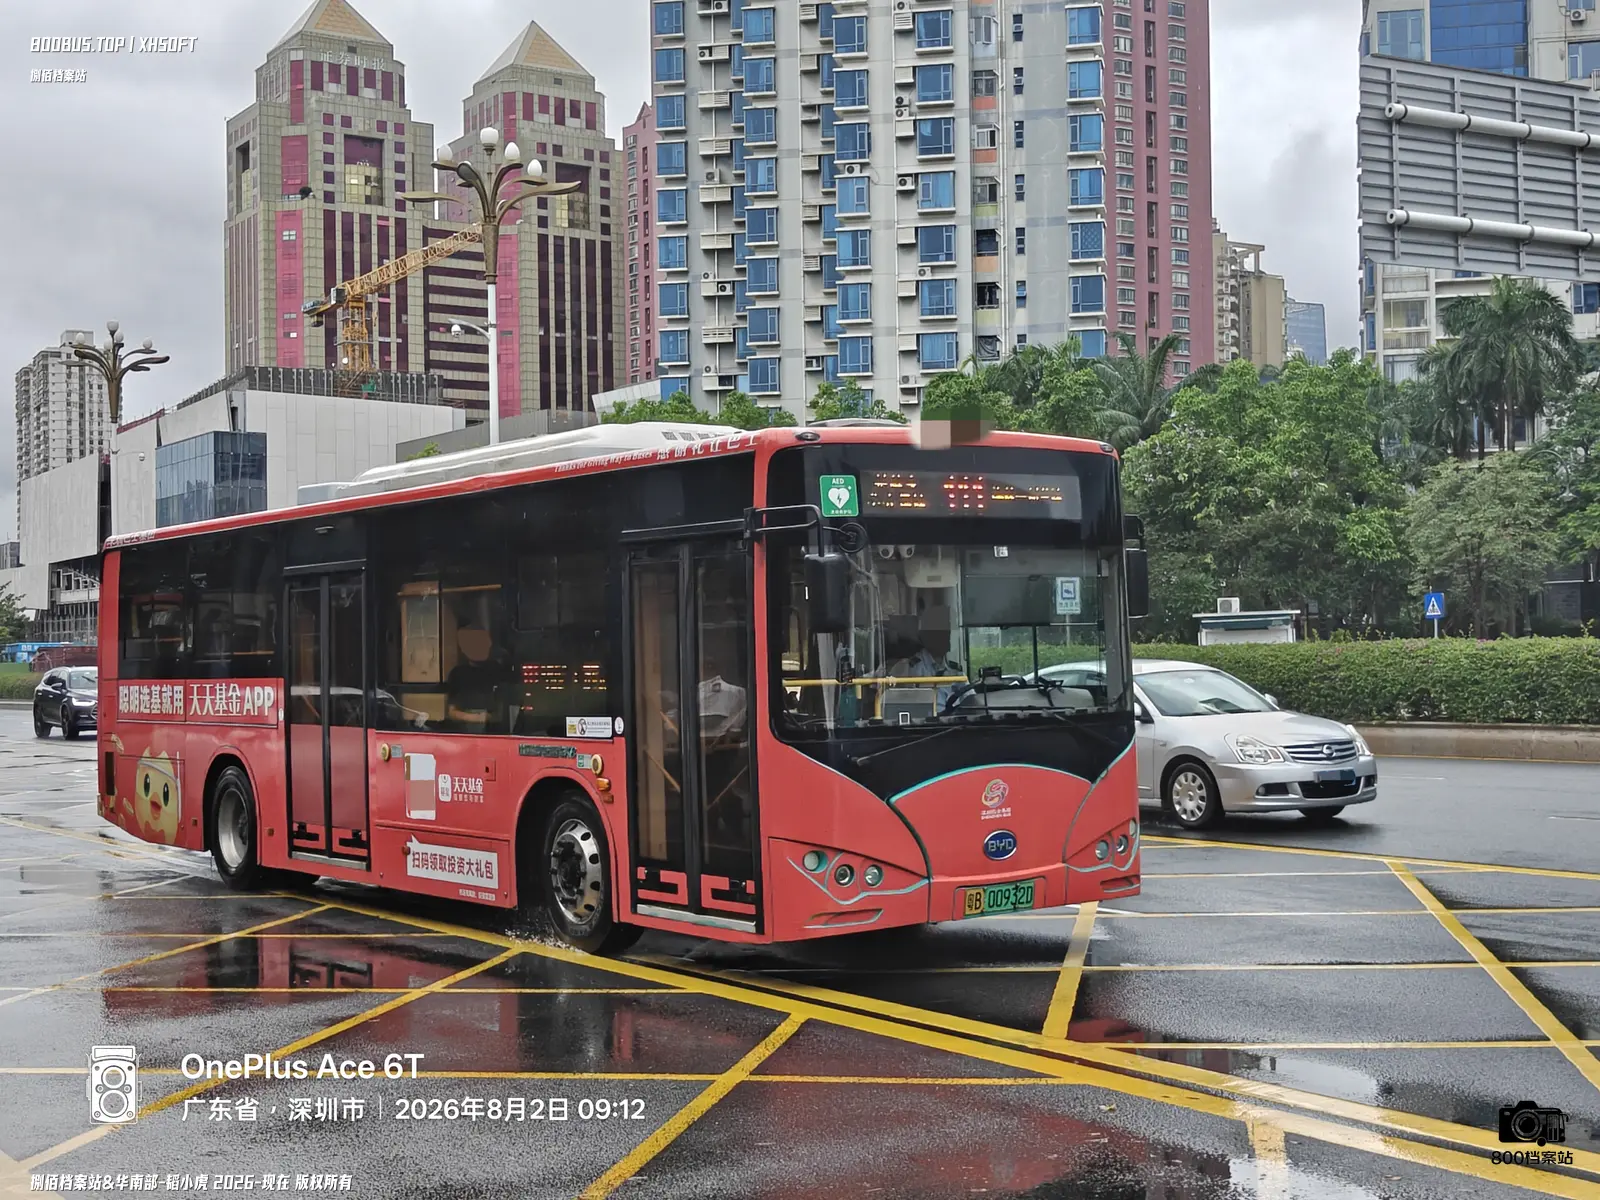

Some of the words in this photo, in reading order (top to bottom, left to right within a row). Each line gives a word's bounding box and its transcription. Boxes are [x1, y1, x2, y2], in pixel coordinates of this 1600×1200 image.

[831, 477, 845, 485] AED
[118, 685, 185, 716] 聪明选基就用
[188, 682, 275, 717] 天天基金APP
[453, 776, 484, 794] 天天基金
[987, 838, 1014, 852] BYD
[412, 850, 494, 880] 扫码领取投资大礼包
